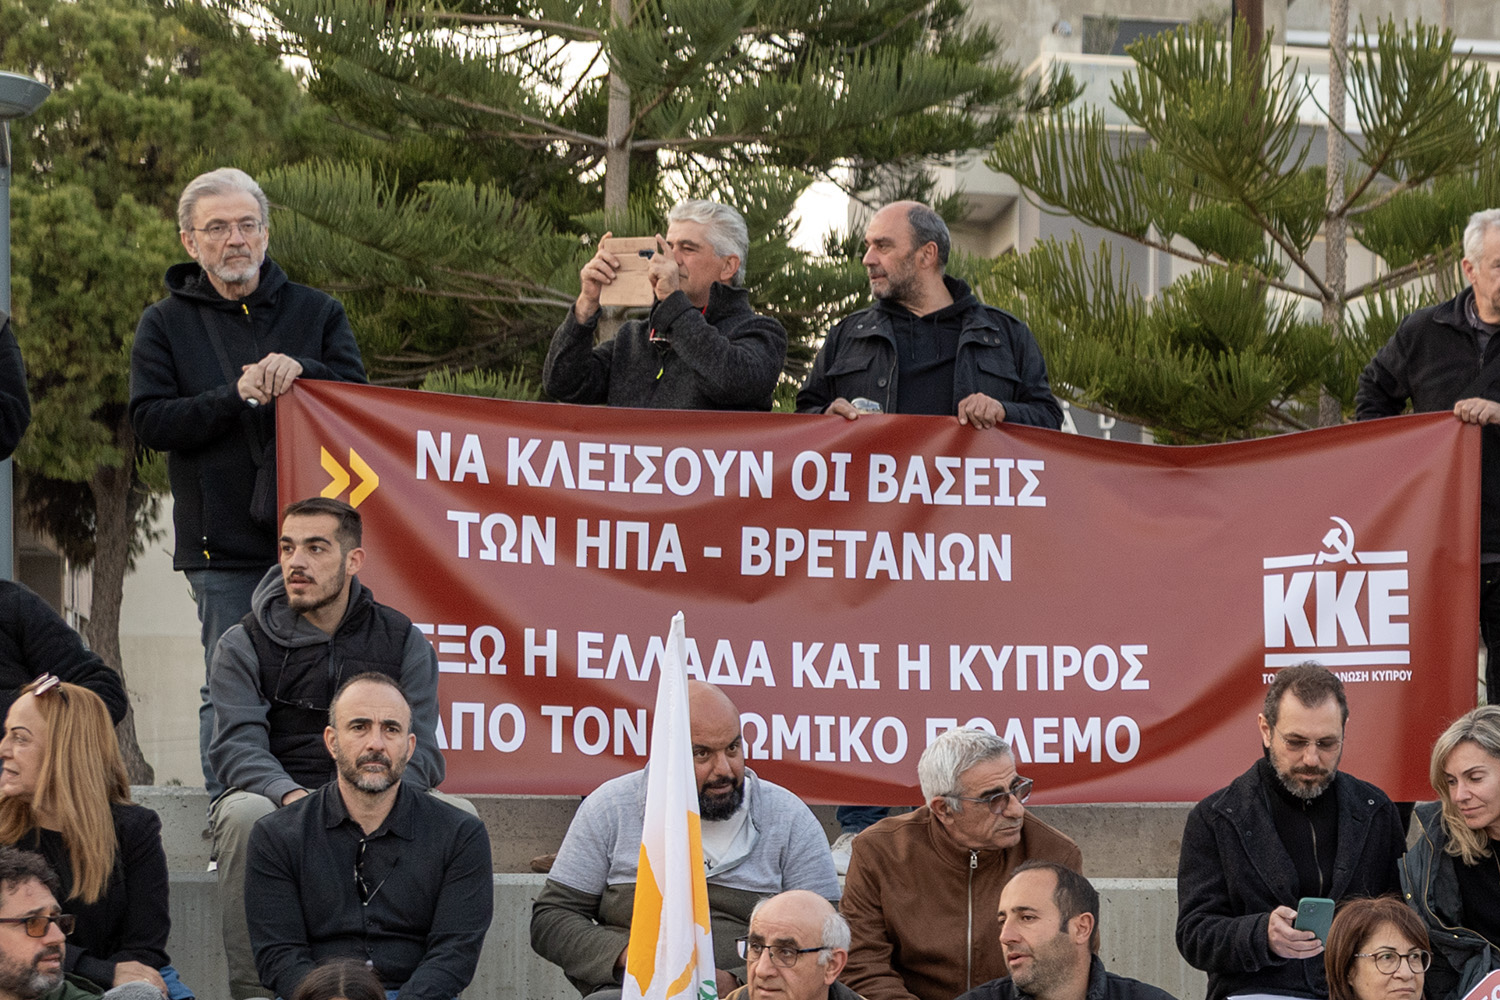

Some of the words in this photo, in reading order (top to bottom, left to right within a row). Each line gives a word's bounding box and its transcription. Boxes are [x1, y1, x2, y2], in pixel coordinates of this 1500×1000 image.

[416, 430, 489, 483] ΝΑ
[507, 437, 773, 498] ΚΛΕΙΣΟΥΝ
[791, 451, 852, 501] ΟΙ
[868, 453, 1046, 507] ΒΑΣΕΙΣ
[447, 511, 556, 566] ΤΩΝ
[576, 519, 687, 573] ΗΠΑ
[703, 546, 722, 558] -
[741, 526, 1012, 582] ΒΡΕΤΑΝΩΝ
[1263, 569, 1410, 648] ΚΚΕ
[524, 628, 557, 677] Η
[792, 641, 880, 689] ΚΑΙ
[899, 644, 931, 691] Η
[950, 644, 1151, 692] ΚΥΠΡΟΣ
[1372, 670, 1412, 682] ΚΥΠΡΟΥ
[541, 705, 647, 756] ΤΟΝ
[742, 712, 908, 765] ΩΜΙΚΟ
